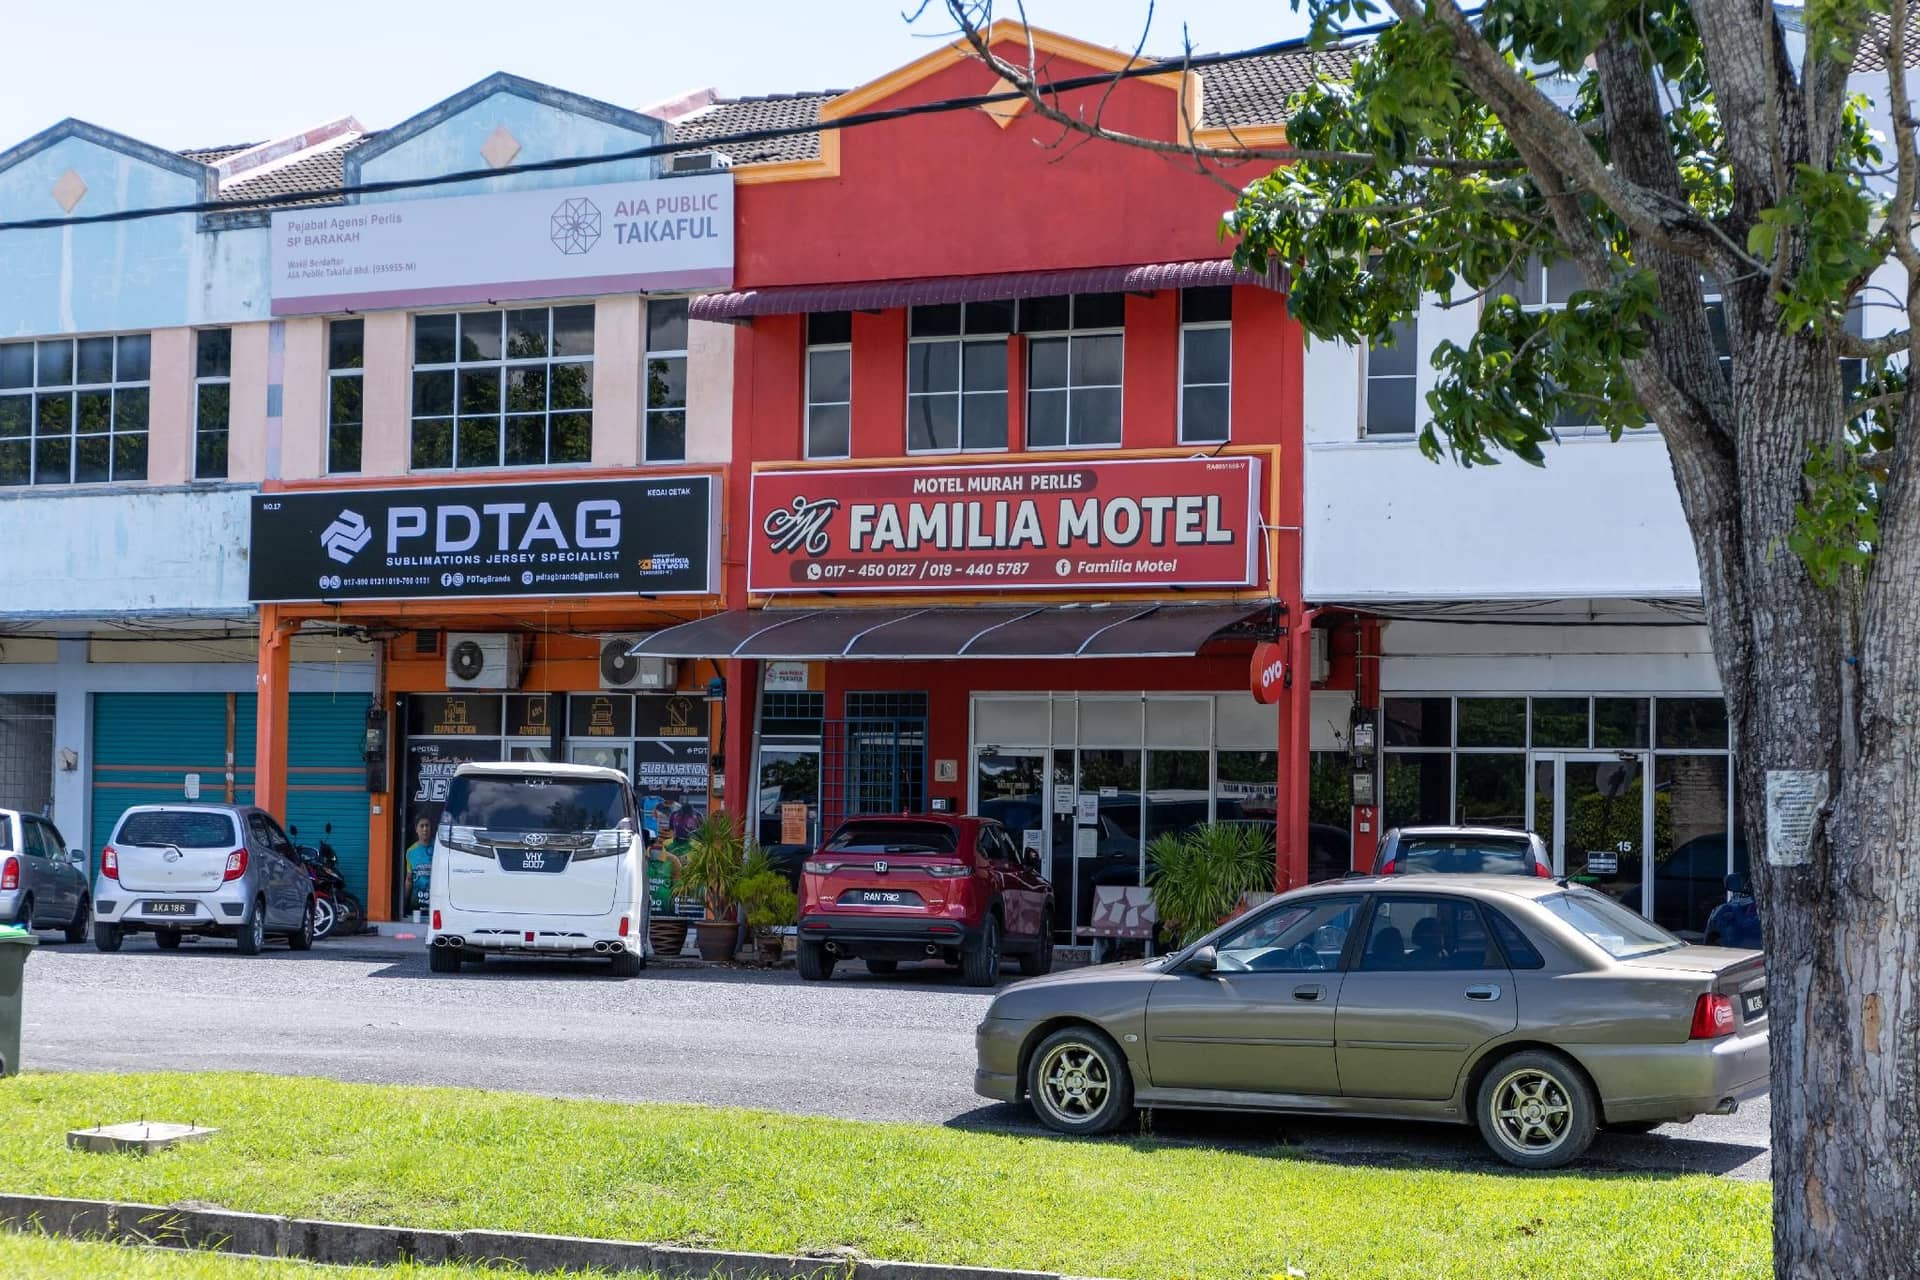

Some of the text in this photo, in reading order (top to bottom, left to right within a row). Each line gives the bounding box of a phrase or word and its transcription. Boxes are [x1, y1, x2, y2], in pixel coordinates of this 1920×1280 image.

[614, 193, 719, 217] AIA PUBLIC
[330, 216, 367, 230] Agensi
[370, 213, 403, 225] Perlis
[613, 216, 719, 245] TAKAFUL
[287, 232, 361, 247] SP BARAKAH
[913, 473, 1082, 494] MOTEL MURAH PERLIS
[386, 499, 622, 554] PDTAG
[850, 495, 1233, 550] FAMILIA MOTEL
[386, 551, 620, 567] SUBLIMATIONS JERSEY SPECIALIST
[1077, 558, 1178, 574] Familia Motel
[824, 564, 846, 578] 017
[858, 564, 884, 577] 450
[887, 562, 917, 576] 0127
[965, 562, 993, 576] 440
[997, 560, 1030, 576] 5787
[1262, 660, 1282, 688] OYO
[1616, 841, 1632, 852] 15
[522, 860, 545, 869] 6007
[525, 852, 542, 861] VHY
[863, 892, 881, 902] RAN
[152, 903, 186, 913] AKA 186
